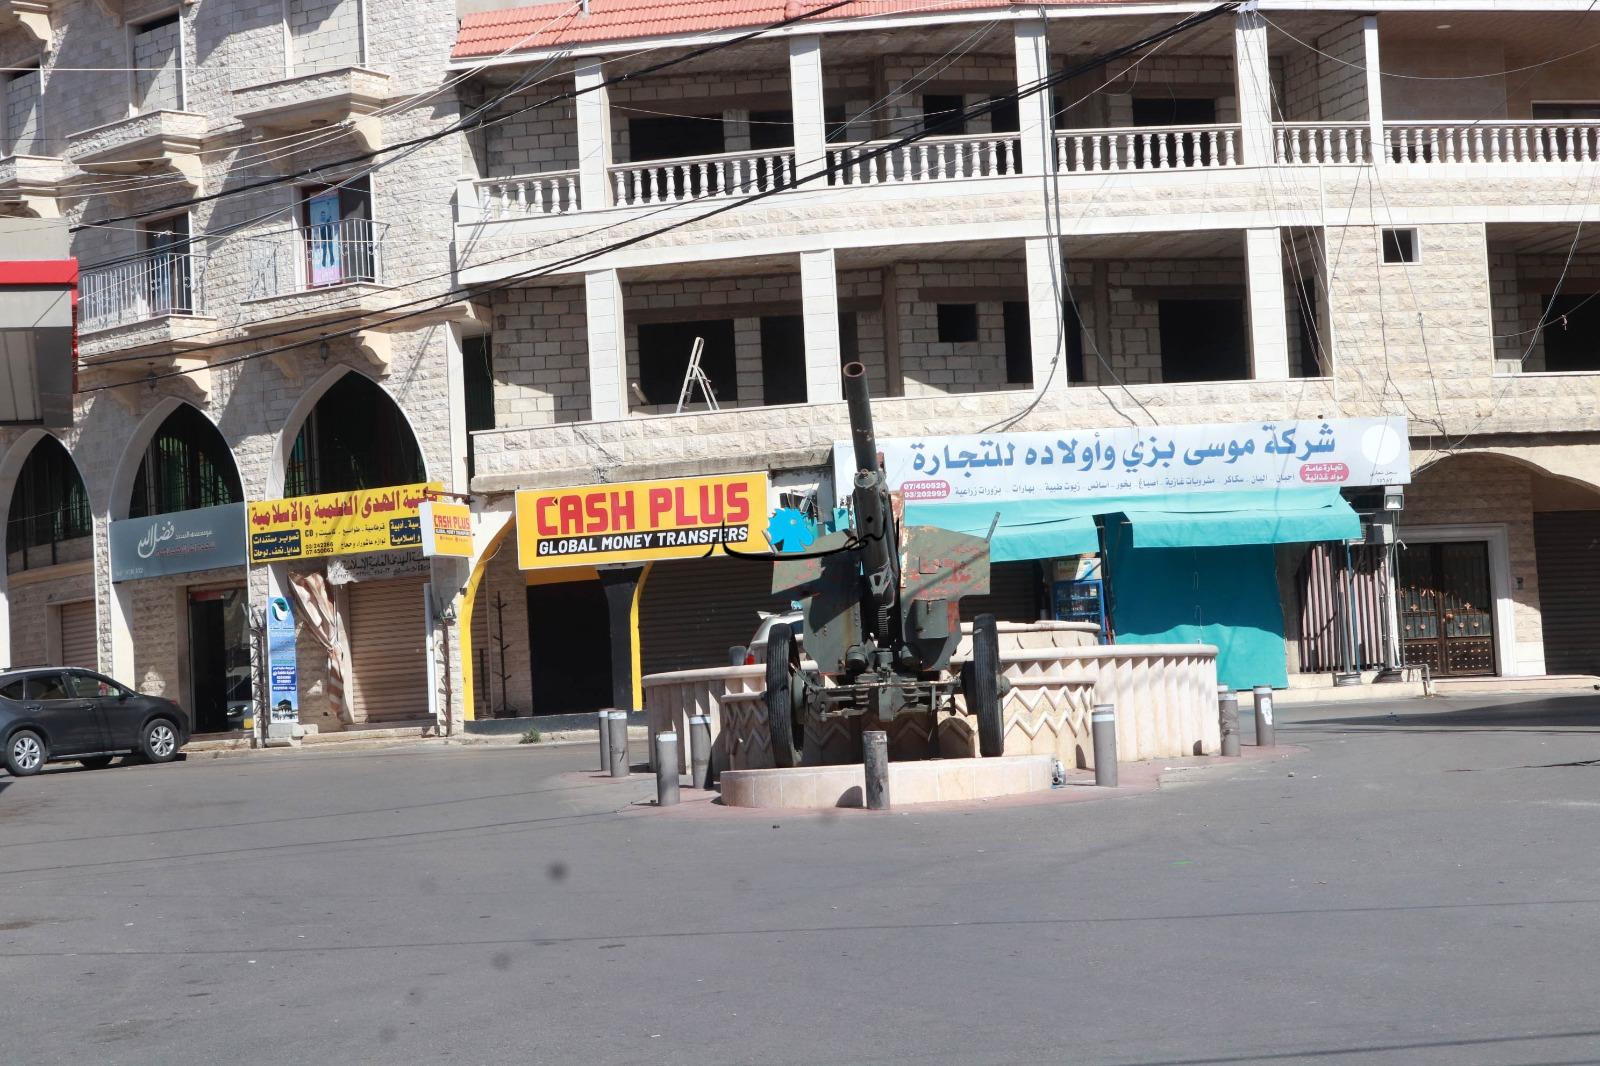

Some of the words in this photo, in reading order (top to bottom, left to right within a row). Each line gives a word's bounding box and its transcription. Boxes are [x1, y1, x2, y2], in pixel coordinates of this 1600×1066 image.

[910, 440, 1016, 478] للتجارة
[1024, 431, 1116, 472] وأولاده
[1122, 436, 1176, 473] بزي
[1183, 438, 1255, 465] موسى
[1262, 422, 1335, 462] شركة
[361, 489, 400, 519] الهدى
[434, 514, 452, 528] CASH
[453, 516, 471, 530] PLUS
[536, 490, 636, 537] CASH
[649, 482, 750, 529] PLUS
[539, 537, 597, 555] GLOBAL
[601, 533, 653, 550] MONEY
[656, 527, 748, 546] TRANSFERS
